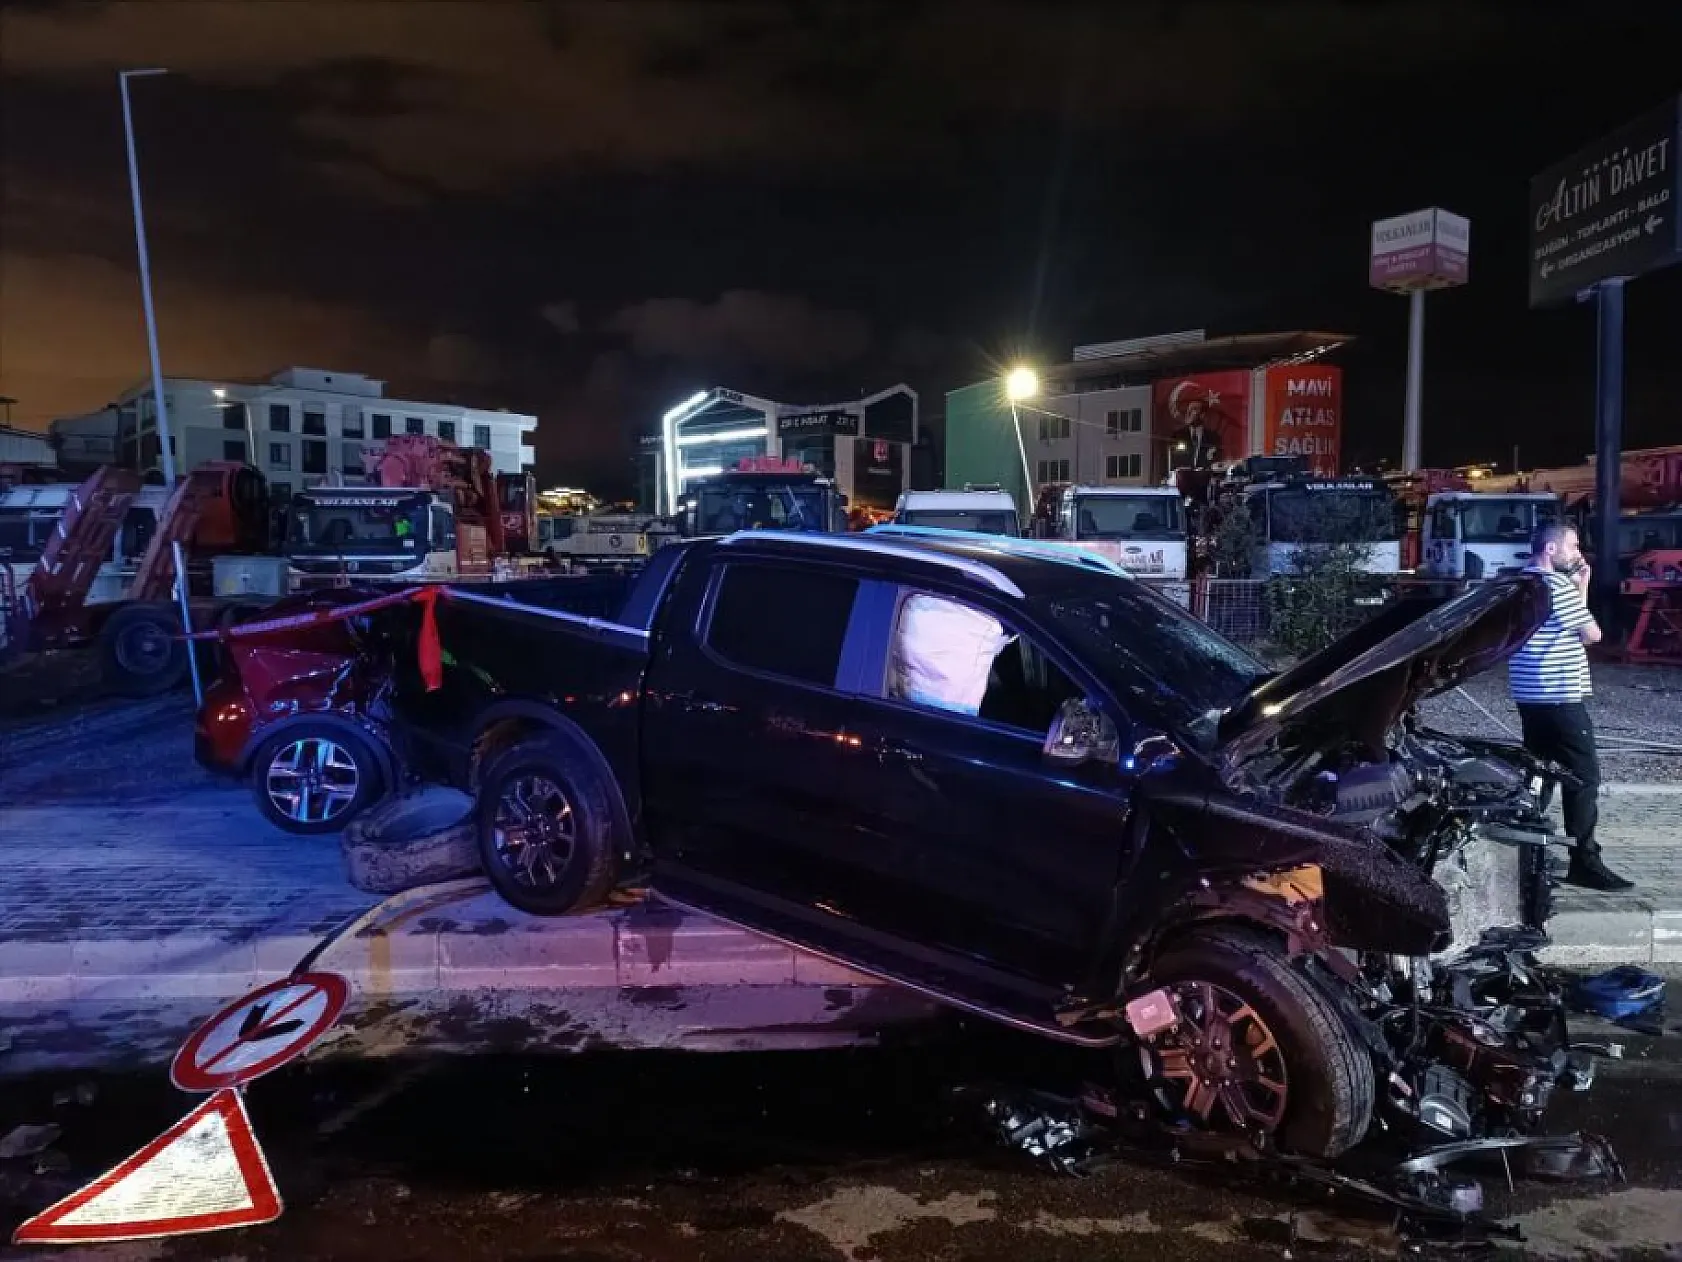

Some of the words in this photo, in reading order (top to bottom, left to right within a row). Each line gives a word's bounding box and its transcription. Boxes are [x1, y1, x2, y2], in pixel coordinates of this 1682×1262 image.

[1535, 176, 1600, 232] ALTIN
[1610, 137, 1670, 195] DAVET
[1287, 375, 1332, 397] MAVİ
[1279, 407, 1335, 426] ATLAS
[1305, 481, 1374, 491] VOLKANLAR
